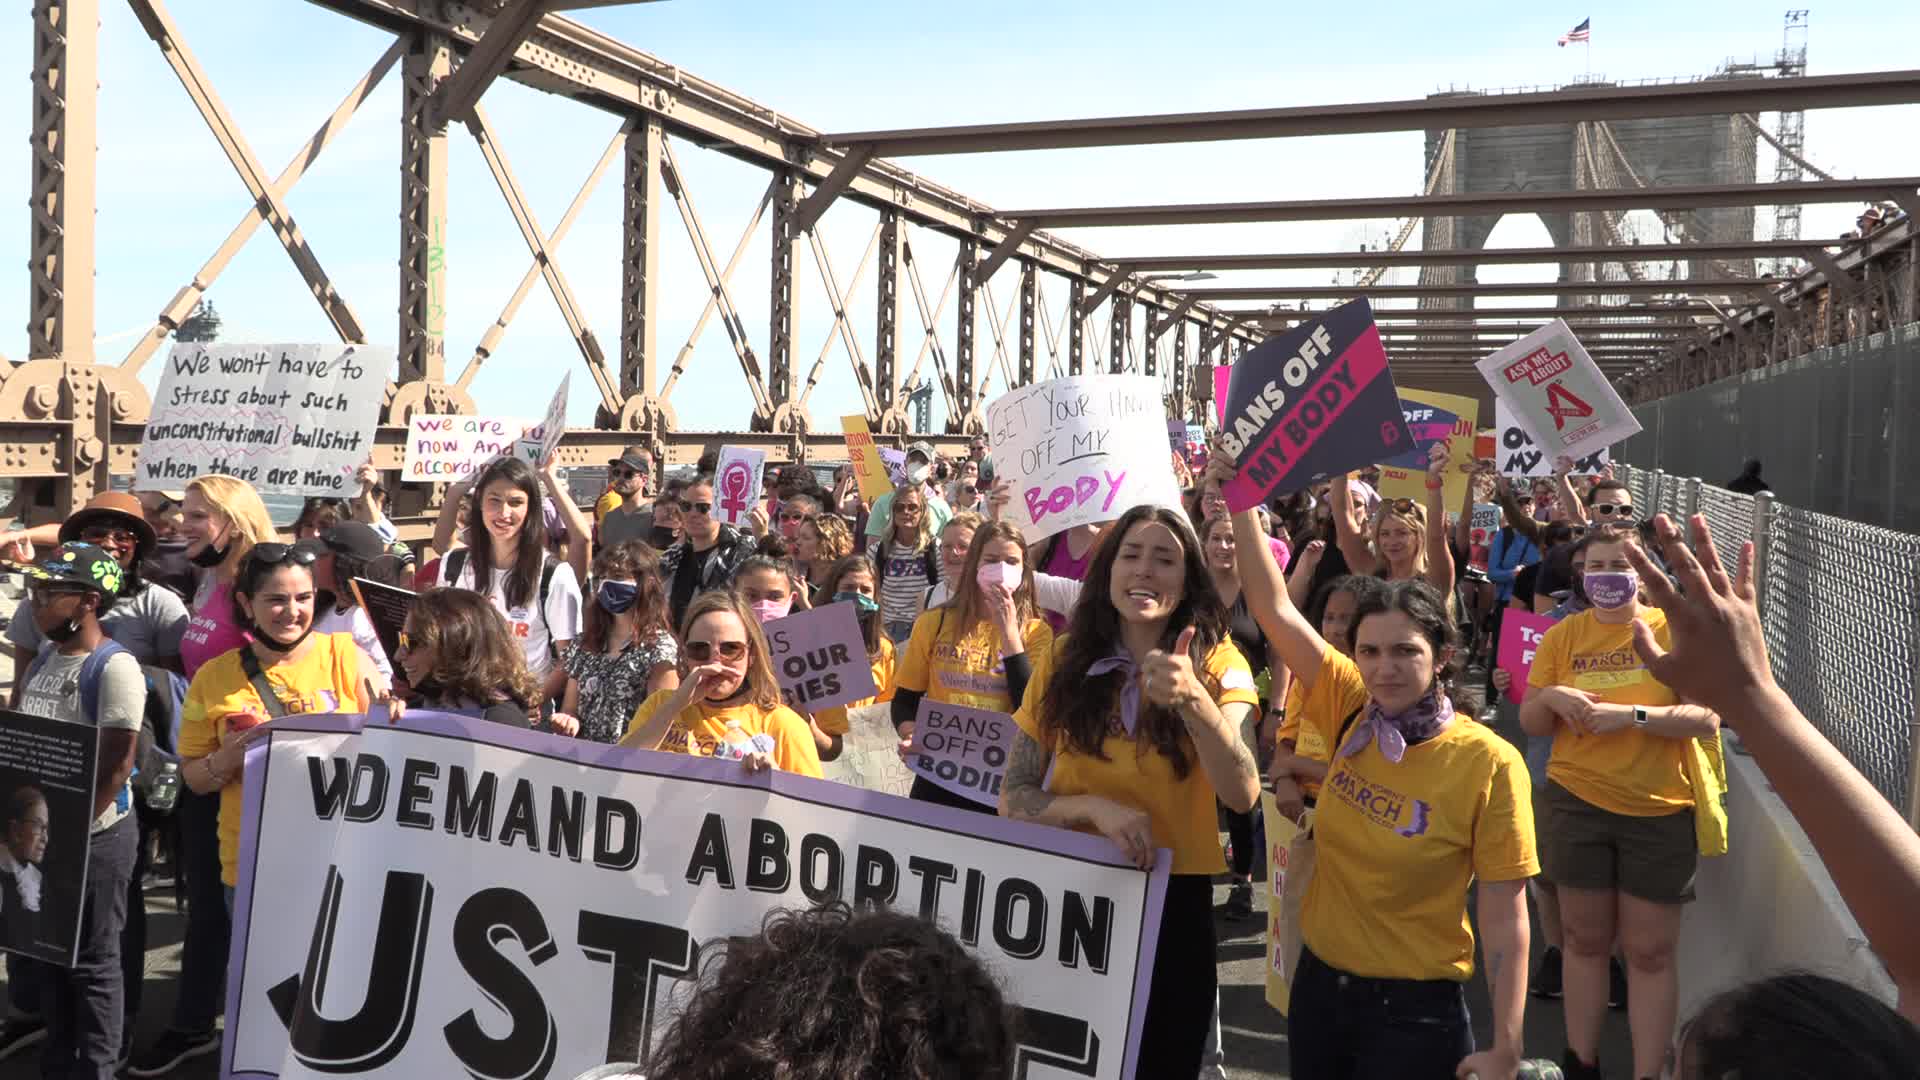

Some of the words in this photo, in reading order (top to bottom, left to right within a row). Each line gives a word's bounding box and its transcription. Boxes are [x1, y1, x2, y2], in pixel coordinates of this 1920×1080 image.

[173, 352, 210, 376] We
[219, 352, 270, 375] won't
[278, 352, 328, 378] have
[341, 359, 363, 380] to
[1509, 360, 1533, 380] ASK
[1532, 351, 1551, 367] ME
[1532, 356, 1568, 382] ABOUT
[238, 386, 291, 409] about
[301, 391, 348, 412] such
[1222, 381, 1285, 459] BANS
[1283, 325, 1332, 387] OFF
[416, 418, 453, 432] we
[464, 420, 505, 435] are
[992, 395, 1028, 447] GET
[1042, 388, 1096, 427] YOUR
[1247, 437, 1287, 489] MY
[1285, 361, 1357, 443] BODY
[150, 417, 282, 446] unconstitutional
[292, 424, 362, 451] bullshit
[1021, 436, 1056, 475] OFF
[1073, 429, 1109, 456] MY
[1503, 450, 1544, 475] MY
[208, 458, 258, 482] there
[267, 467, 297, 486] are
[1024, 470, 1126, 525] BODY
[783, 643, 851, 678] OUR
[1572, 652, 1635, 671] MARCH
[927, 710, 1002, 740] BANS
[923, 732, 978, 757] OFF
[1331, 771, 1402, 822] MARCH
[685, 813, 1115, 975] ABORTION
